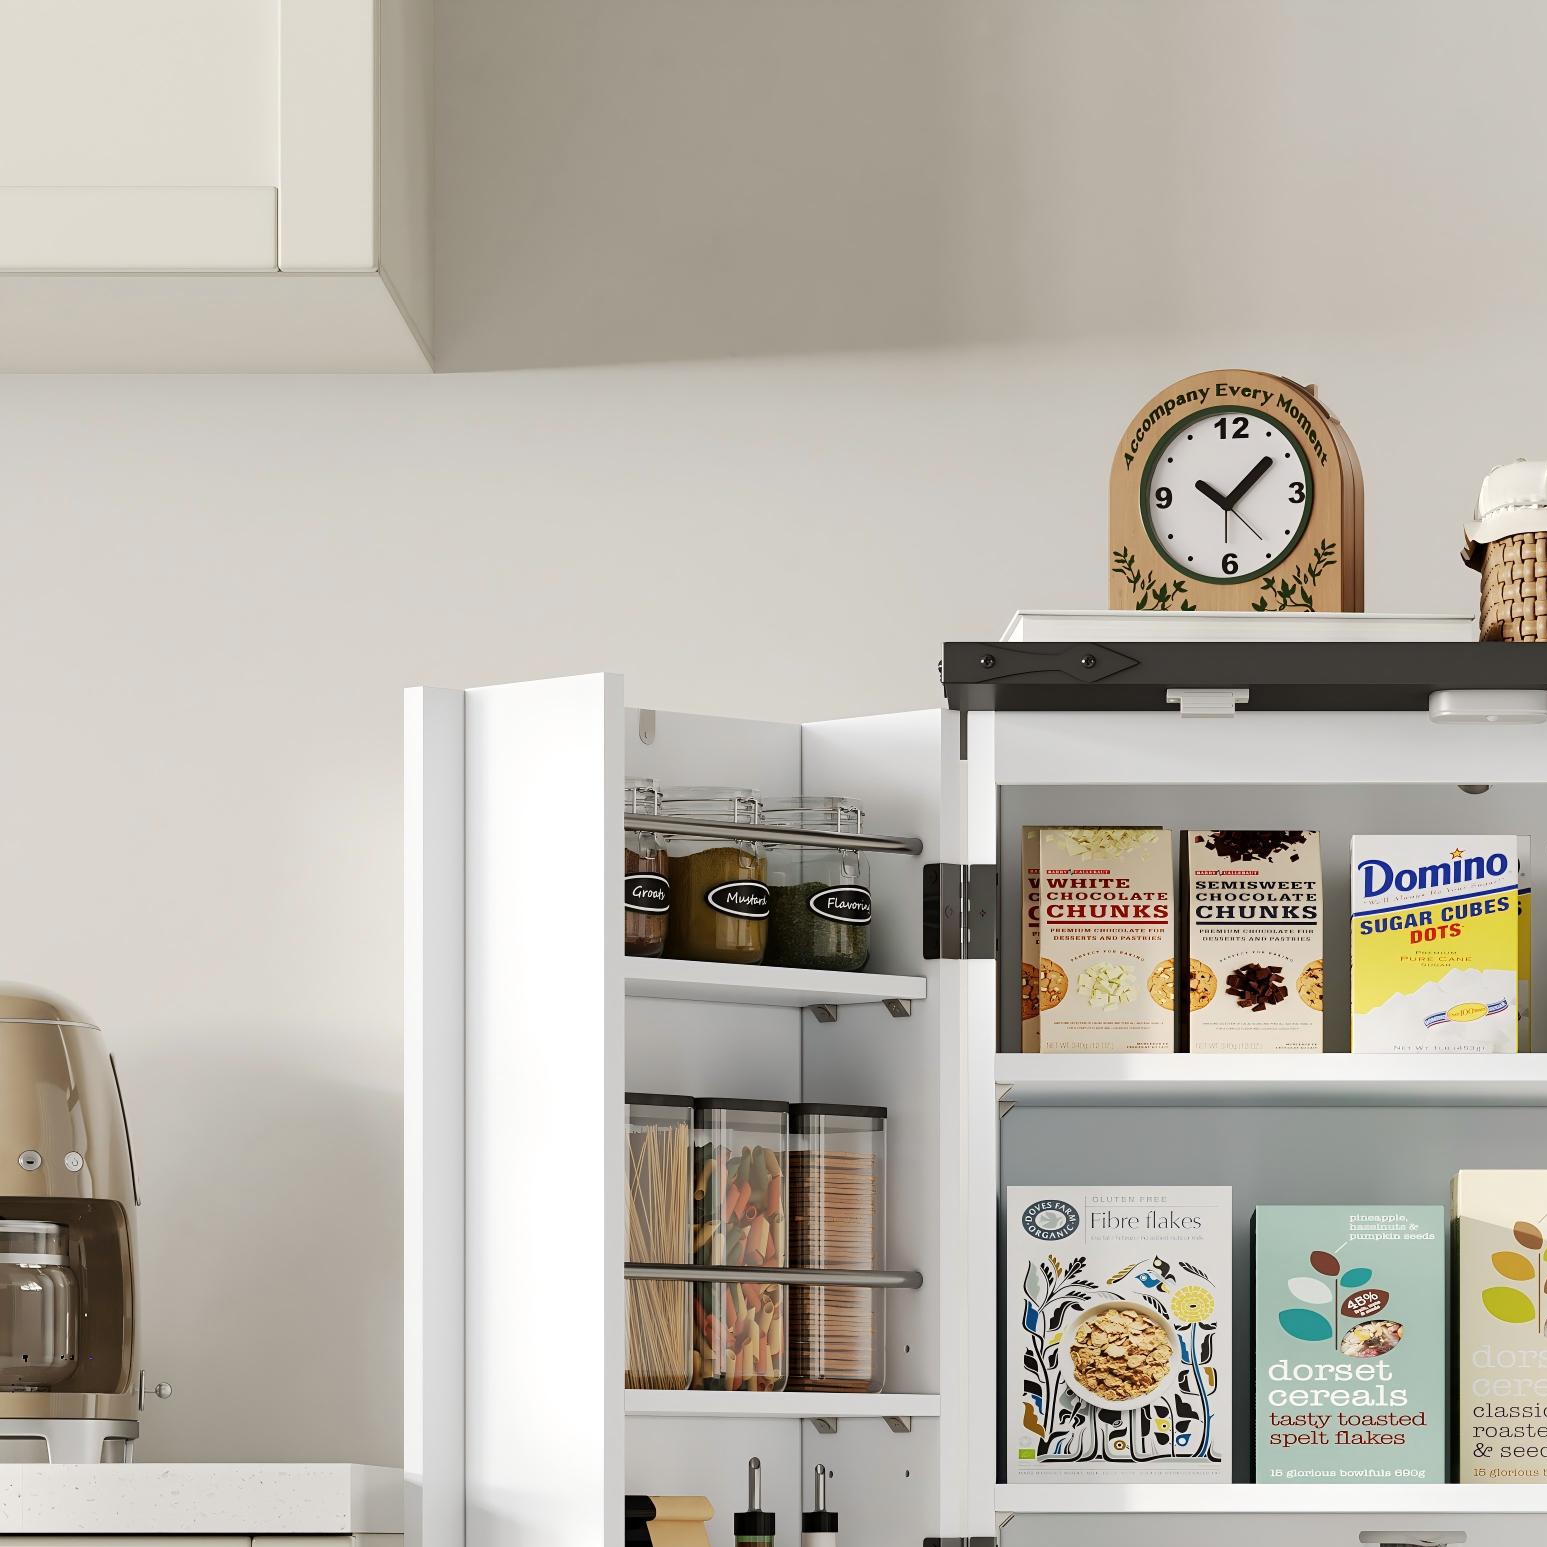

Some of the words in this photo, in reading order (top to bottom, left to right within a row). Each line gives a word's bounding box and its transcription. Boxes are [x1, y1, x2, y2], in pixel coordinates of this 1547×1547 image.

[1124, 386, 1211, 471] Accompany
[1215, 383, 1275, 406] Every
[1276, 393, 1329, 468] Moment
[1214, 416, 1250, 440] 12
[1155, 487, 1173, 509] 9
[1288, 481, 1306, 504] 3
[1221, 553, 1239, 575] 6
[1357, 850, 1508, 898] Domino
[1046, 878, 1130, 888] WHITE
[1195, 881, 1316, 890] SEMISWEET
[726, 892, 768, 906] Mustard
[1046, 892, 1168, 900] CHOCOLATE
[1195, 893, 1317, 902] CHOCOLATE
[1046, 905, 1168, 918] CHUNKS
[1195, 905, 1317, 919] CHUNKS
[1360, 910, 1432, 935] SUGAR
[1441, 896, 1510, 922] CUBES
[1410, 923, 1462, 944] DOTS
[1025, 1202, 1052, 1223] DOVES
[1055, 1202, 1076, 1223] FARM
[1091, 1211, 1139, 1229] Fibre
[1146, 1211, 1201, 1229] flakes
[1028, 1224, 1075, 1240] ORGANIC
[1350, 1232, 1400, 1240] pumpkin
[1404, 1232, 1435, 1240] seeds
[1267, 1360, 1393, 1381] dorset
[1267, 1385, 1408, 1406] cereals
[1269, 1412, 1332, 1428] tasty
[1337, 1411, 1427, 1426] toasted
[1269, 1431, 1329, 1447] spelt
[1334, 1430, 1405, 1445] flakes
[1473, 1442, 1493, 1458] &
[1286, 1468, 1336, 1479] glorious
[1340, 1468, 1391, 1477] bowlfuls
[1489, 1468, 1539, 1479] glorious
